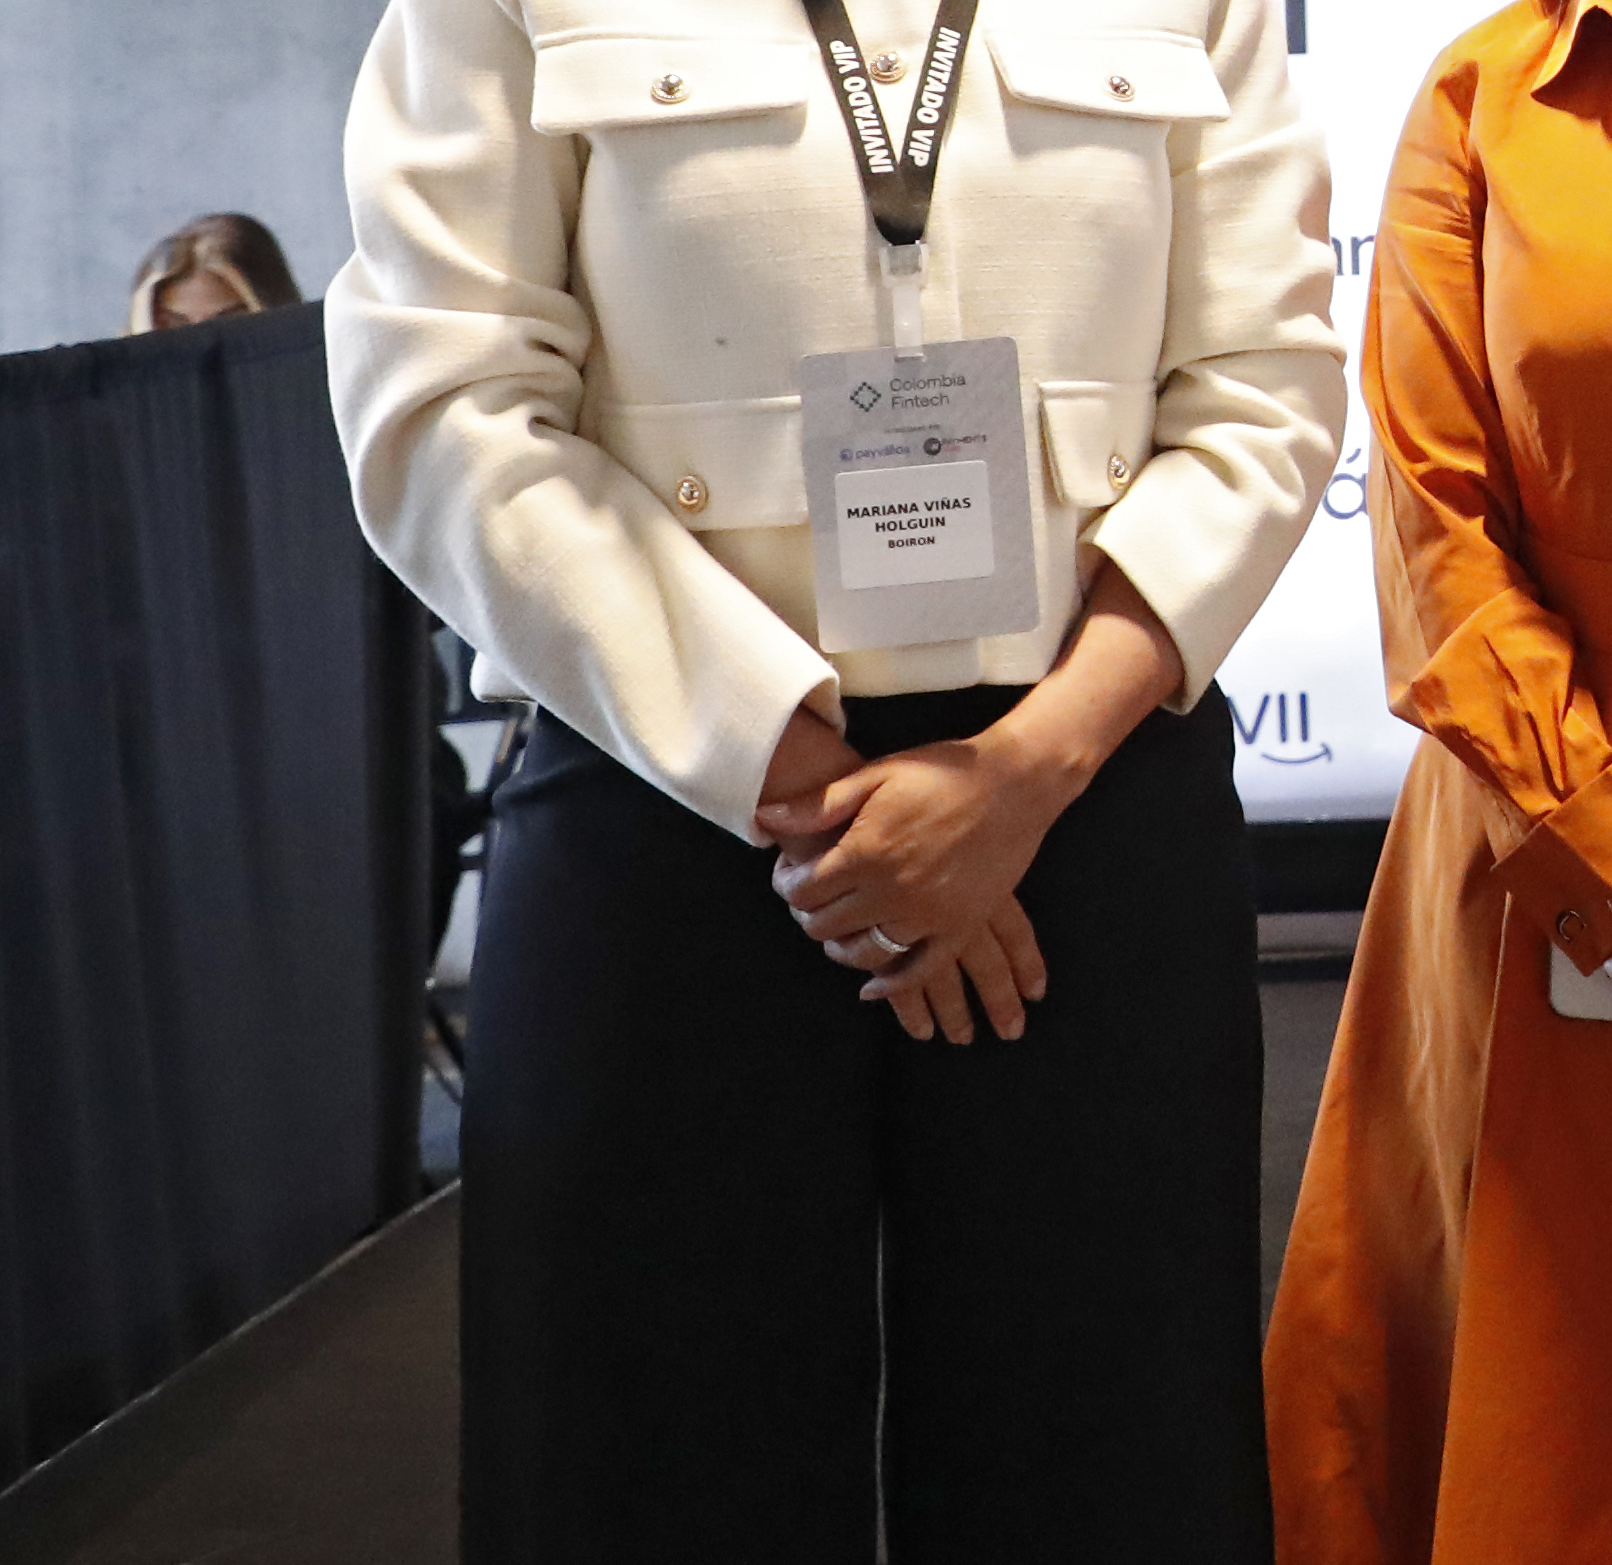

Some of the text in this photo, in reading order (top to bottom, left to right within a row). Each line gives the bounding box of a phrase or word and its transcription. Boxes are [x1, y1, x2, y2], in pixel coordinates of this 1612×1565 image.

[913, 26, 960, 168] INVITADO VIP
[829, 40, 894, 174] INVITADO VIP
[889, 373, 967, 392] Colombia
[891, 393, 951, 410] Fintech
[847, 496, 972, 519] MARIANA VIÑAS
[874, 515, 946, 533] HOLGUIN
[887, 536, 936, 549] BOIRON
